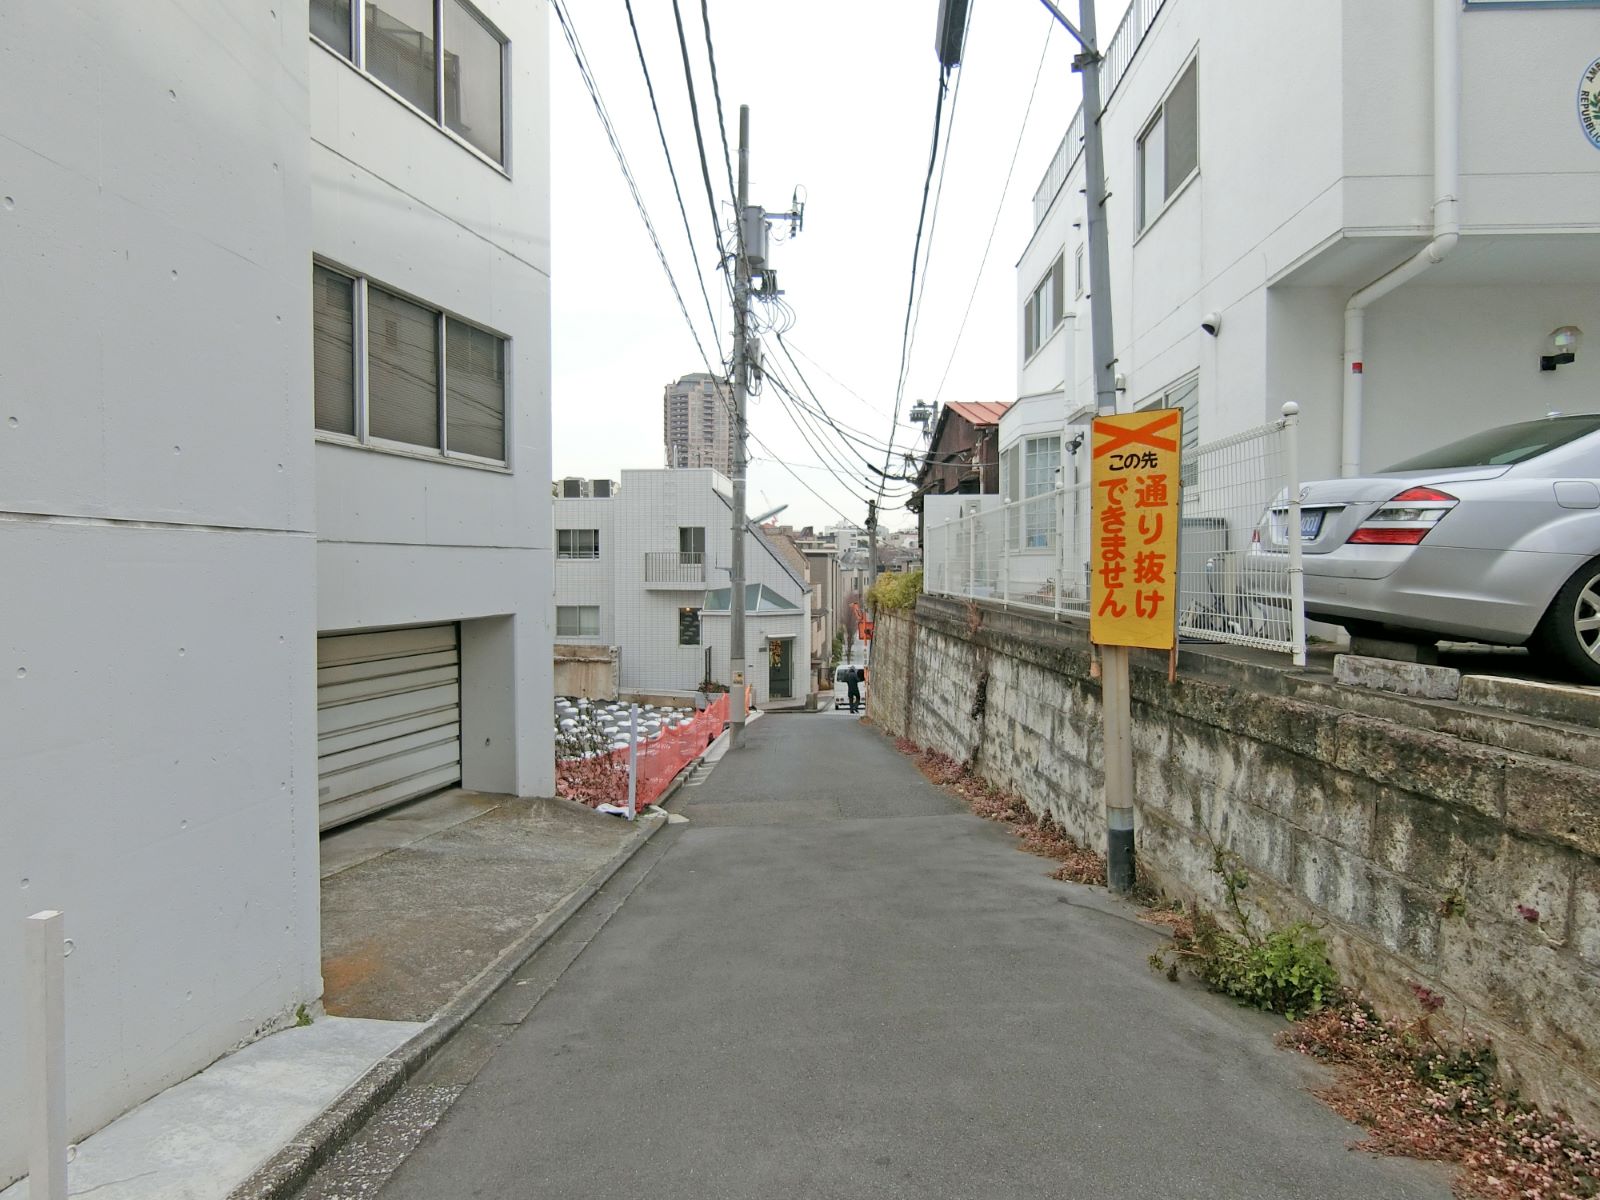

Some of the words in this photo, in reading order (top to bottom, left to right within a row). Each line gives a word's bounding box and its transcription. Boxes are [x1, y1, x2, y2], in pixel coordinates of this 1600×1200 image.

[1109, 451, 1158, 471] この先
[1098, 477, 1127, 618] できません
[1133, 474, 1168, 619] 通り抜け
